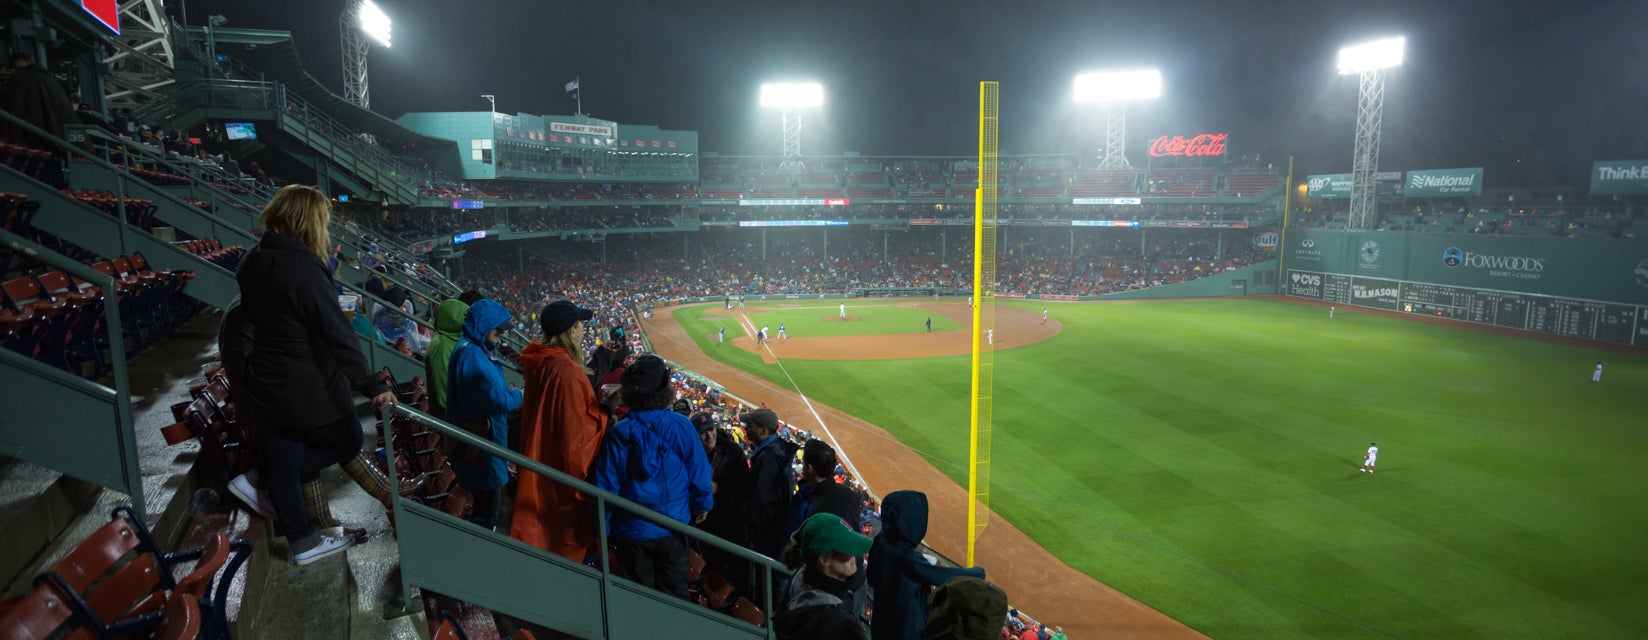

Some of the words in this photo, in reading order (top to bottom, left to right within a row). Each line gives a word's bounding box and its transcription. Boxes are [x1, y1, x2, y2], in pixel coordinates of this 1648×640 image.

[554, 124, 585, 132] FENWAY
[69, 134, 85, 142] 35
[1424, 174, 1475, 187] National
[1255, 235, 1277, 245] Gulf
[1464, 252, 1544, 272] FOXWOODS
[1300, 274, 1321, 286] CVS
[1291, 284, 1320, 297] Health
